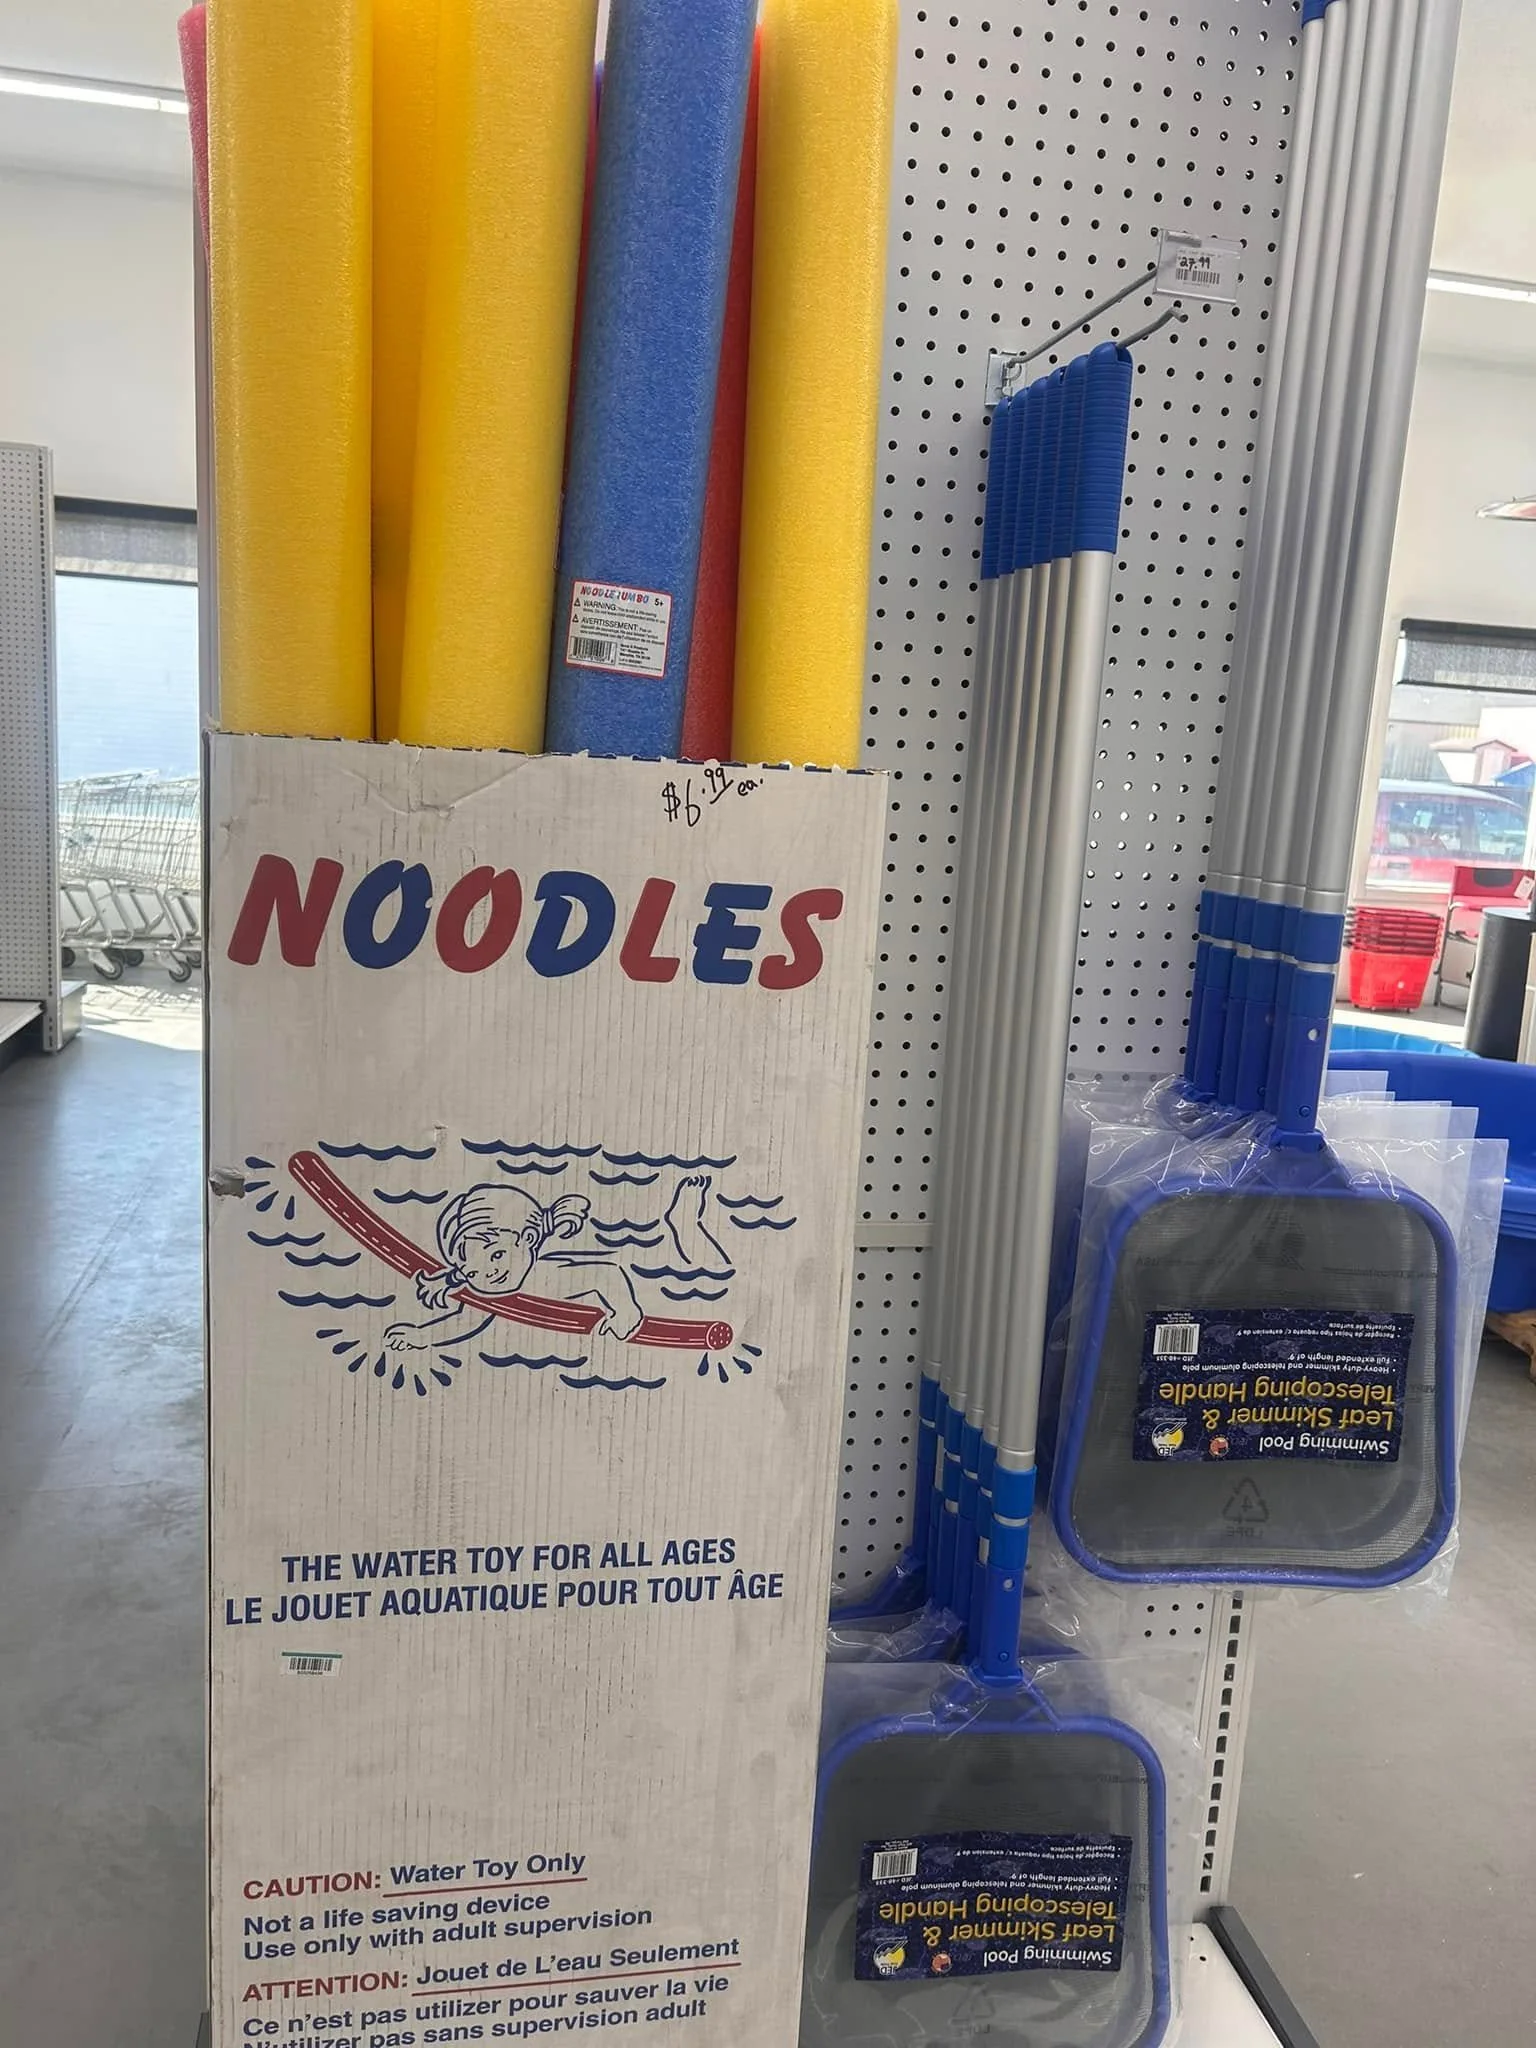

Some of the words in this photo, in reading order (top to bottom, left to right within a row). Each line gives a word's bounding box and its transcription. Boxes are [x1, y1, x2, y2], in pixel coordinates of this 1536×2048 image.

[581, 586, 615, 598] NOODLE
[654, 598, 664, 606] 5+
[662, 768, 734, 827] $6.99
[738, 778, 763, 796] ea.
[227, 853, 844, 990] NOODLES
[1182, 1364, 1200, 1372] pole
[1202, 1364, 1240, 1372] aluminum
[1242, 1362, 1286, 1371] telescoping
[1306, 1363, 1340, 1372] skimmer
[1308, 1353, 1334, 1362] length
[1336, 1355, 1374, 1364] extended
[1342, 1364, 1389, 1374] Heavy-duty
[1159, 1382, 1246, 1406] Handle
[1255, 1376, 1395, 1405] Telescoping
[1203, 1408, 1220, 1429] &
[1226, 1407, 1333, 1428] Skimmer
[1338, 1410, 1393, 1431] Leaf
[1157, 1448, 1175, 1456] JED
[1259, 1436, 1294, 1452] Pool
[1300, 1433, 1390, 1454] Swimming
[282, 1554, 342, 1583] THE
[352, 1548, 458, 1580] WATER
[466, 1545, 524, 1574] TOY
[532, 1542, 591, 1572] FOR
[600, 1541, 652, 1569] ALL
[661, 1538, 736, 1566] AGES
[225, 1597, 262, 1625] LE
[272, 1590, 373, 1622] JOUET
[380, 1583, 548, 1618] AQUATIQUE
[557, 1580, 638, 1608] POUR
[647, 1575, 721, 1602] TOUT
[728, 1569, 784, 1600] ÂGE
[243, 1870, 382, 1901] CAUTION:
[390, 1860, 466, 1888] Water
[472, 1858, 518, 1883] Toy
[526, 1852, 587, 1878] Only
[921, 1881, 960, 1890] aluminum
[962, 1880, 1007, 1888] telescoping
[1028, 1882, 1062, 1890] skimmer
[1029, 1873, 1056, 1881] length
[901, 1883, 918, 1892] pole
[244, 1915, 292, 1936] Not
[299, 1914, 314, 1931] a
[323, 1908, 364, 1929] life
[371, 1901, 458, 1927] saving
[466, 1892, 550, 1916] device
[879, 1899, 967, 1923] Handle
[975, 1893, 1117, 1919] Telescoping
[244, 1940, 296, 1961] Use
[303, 1933, 361, 1959] only
[369, 1928, 424, 1949] with
[432, 1921, 497, 1943] adult
[504, 1907, 653, 1940] supervision
[922, 1925, 941, 1946] &
[948, 1920, 1056, 1942] Skimmer
[1063, 1924, 1114, 1943] Leaf
[984, 1950, 1019, 1966] Pool
[1024, 1945, 1112, 1964] Swimming
[243, 1972, 409, 2002] ATTENTION:
[416, 1961, 489, 1986] Jouet
[496, 1959, 527, 1978] de
[608, 1938, 740, 1968] Seulement
[880, 1967, 897, 1975] JED
[243, 2017, 280, 2038] Ce
[360, 2006, 407, 2028] pas
[415, 1997, 502, 2022] utilizer
[509, 1991, 568, 2018] pour
[575, 1982, 659, 2005] sauver
[666, 1978, 686, 1997] la
[694, 1975, 729, 1994] vie
[369, 2029, 416, 2048] pas
[423, 2021, 484, 2042] sans
[490, 2007, 638, 2039] supervision
[645, 1999, 707, 2021] adult
